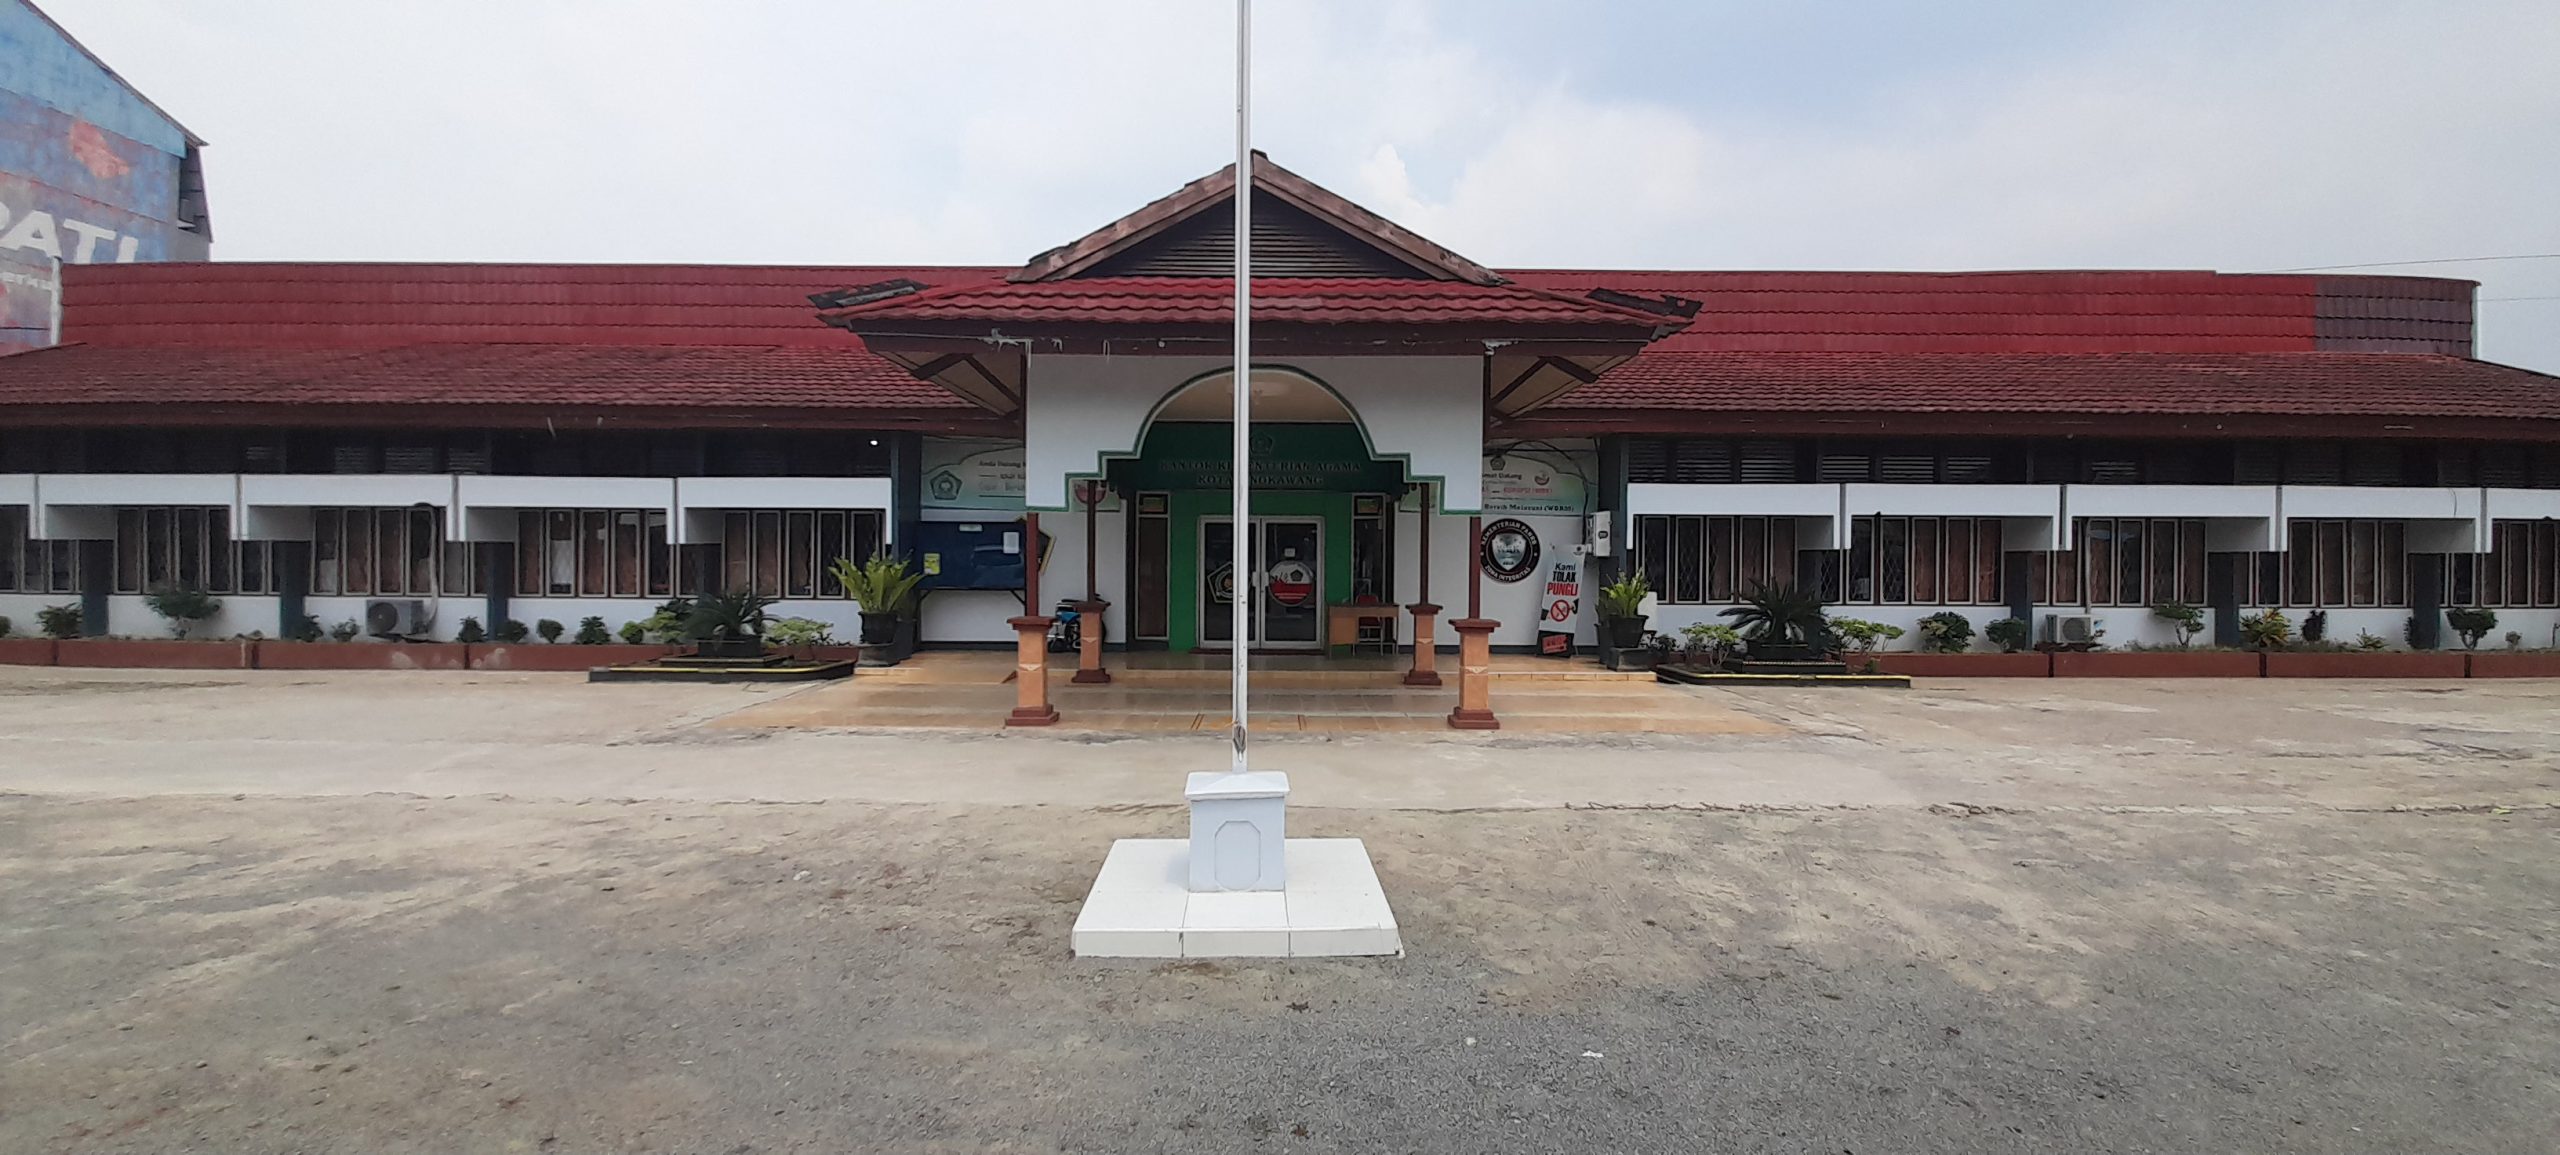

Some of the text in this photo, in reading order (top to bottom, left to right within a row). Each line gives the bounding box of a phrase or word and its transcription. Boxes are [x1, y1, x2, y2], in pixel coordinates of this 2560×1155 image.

[1555, 562, 1576, 571] Kami
[1552, 570, 1577, 582] TOLAK
[1547, 582, 1579, 596] PUNGLI
